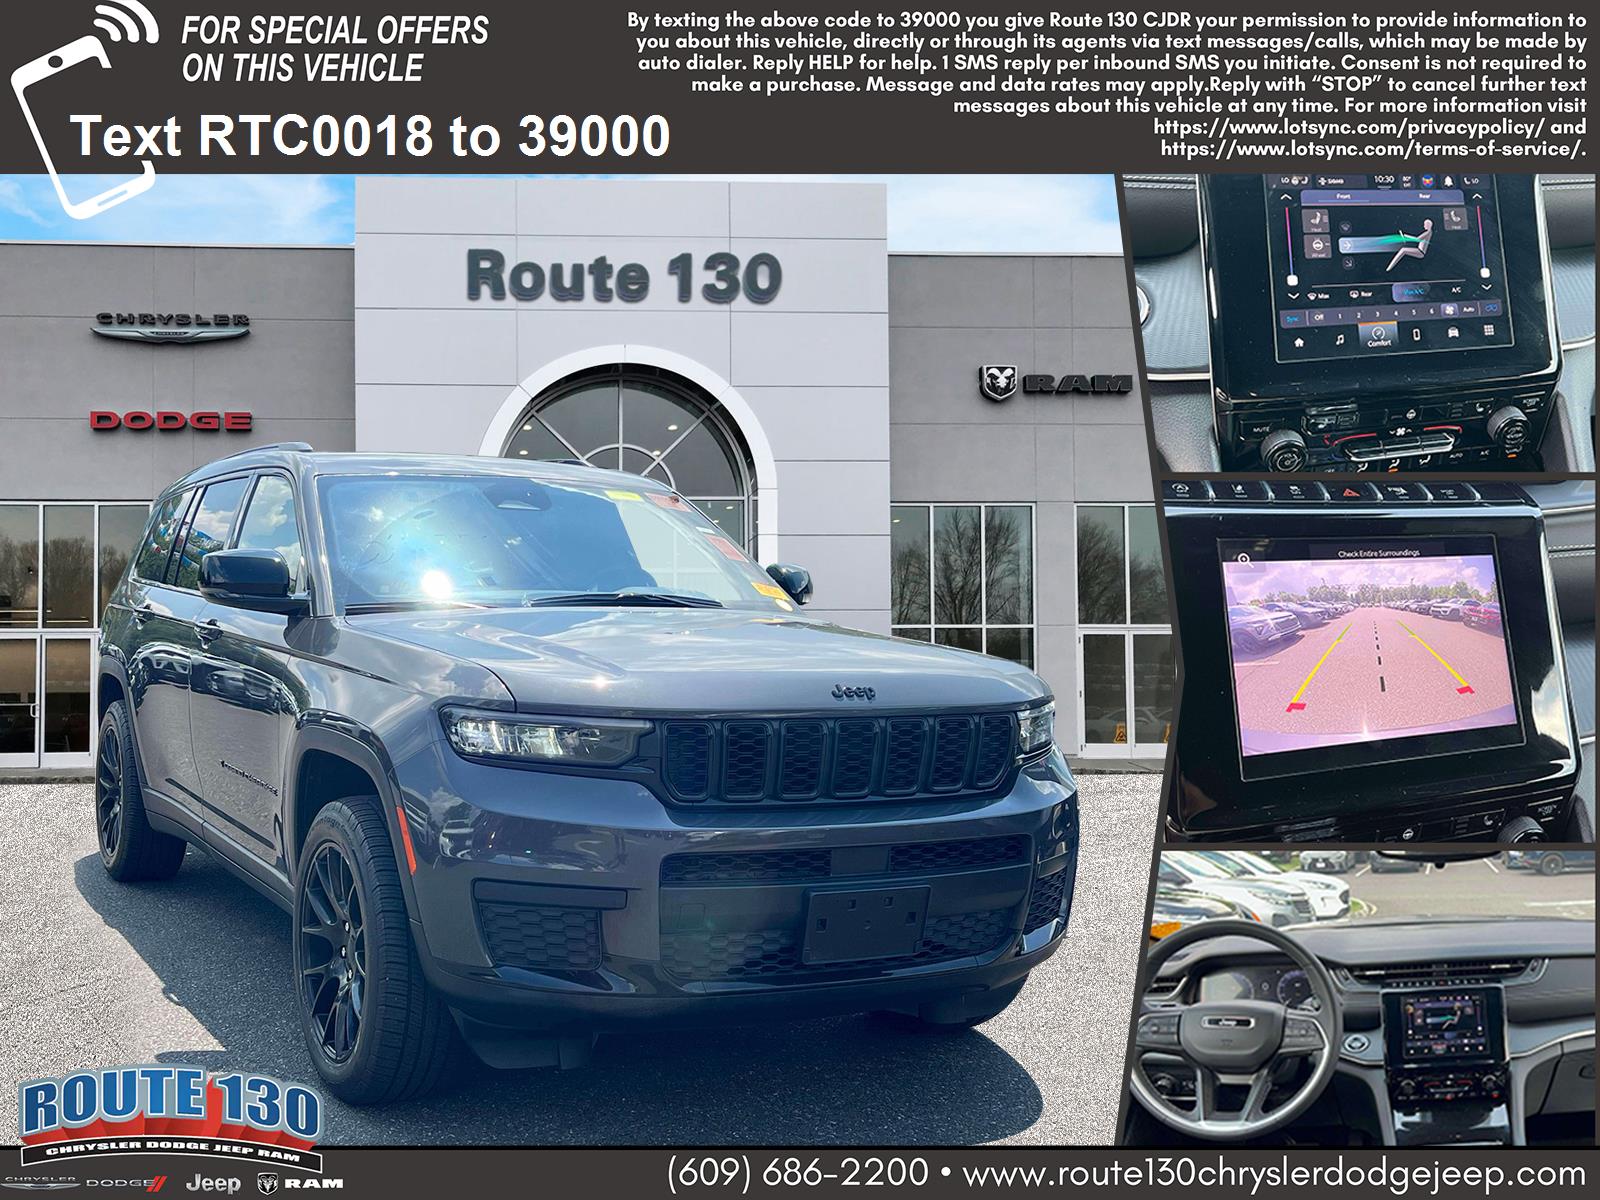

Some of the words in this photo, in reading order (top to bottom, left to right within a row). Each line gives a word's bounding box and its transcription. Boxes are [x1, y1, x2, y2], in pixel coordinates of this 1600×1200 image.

[1374, 175, 1395, 183] 10:30
[466, 248, 650, 303] Route
[667, 251, 783, 305] 130
[96, 312, 250, 326] CHRYSLER
[1367, 339, 1392, 348] Comfort
[1023, 374, 1133, 394] RAM
[89, 410, 252, 431] DODGE
[1338, 550, 1359, 558] Check
[1379, 549, 1420, 558] Surroundings
[831, 684, 876, 703] Jeep
